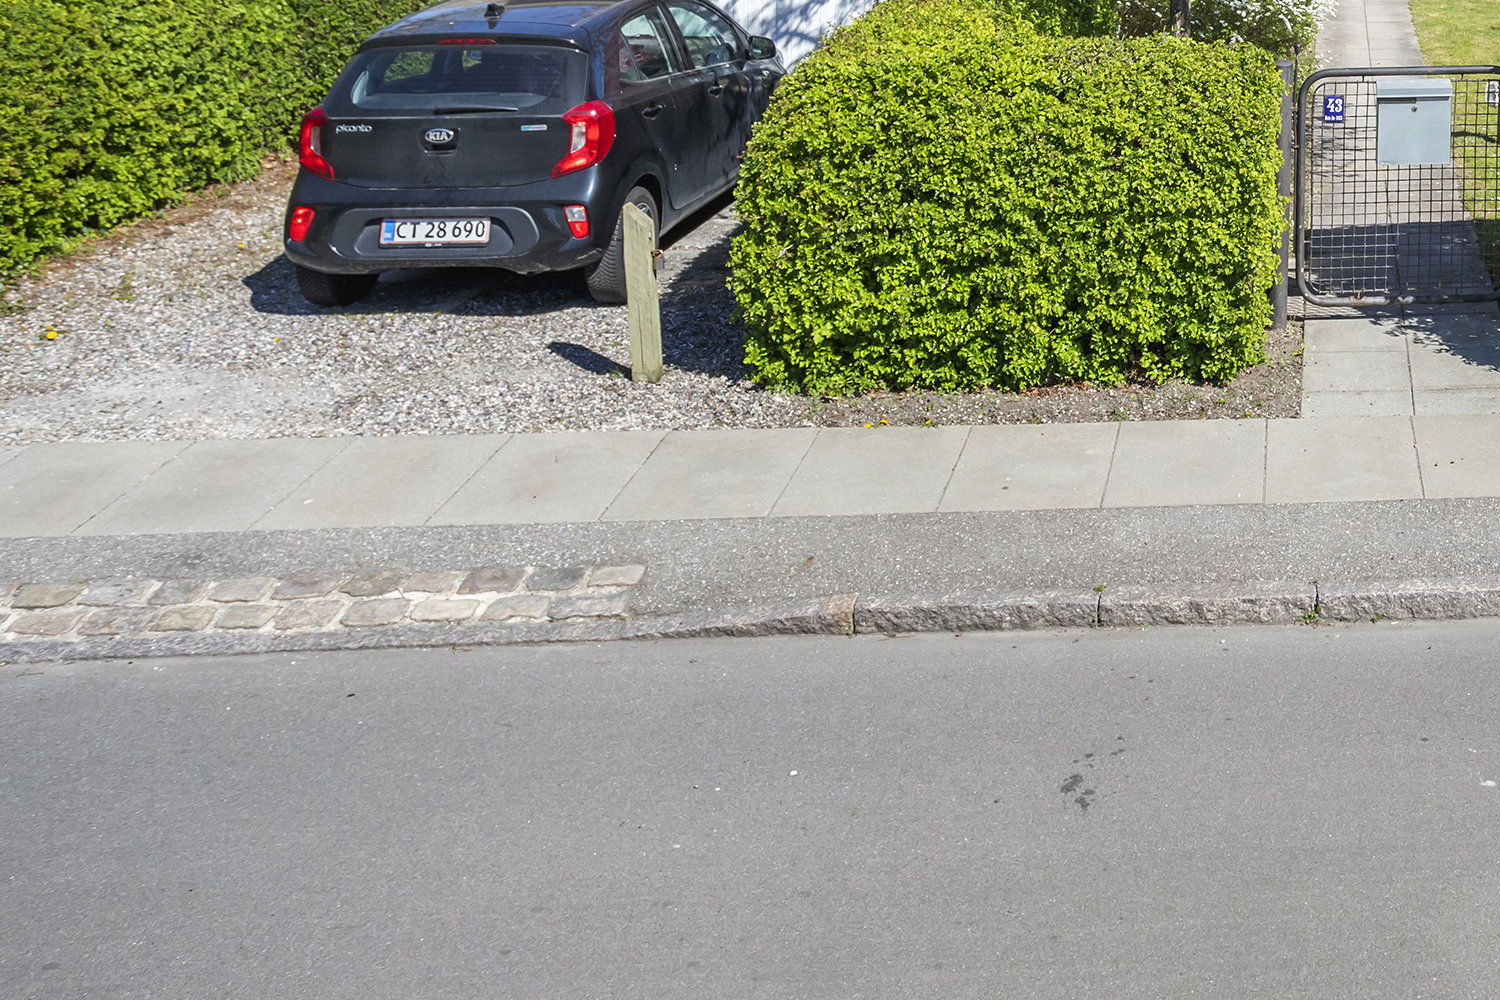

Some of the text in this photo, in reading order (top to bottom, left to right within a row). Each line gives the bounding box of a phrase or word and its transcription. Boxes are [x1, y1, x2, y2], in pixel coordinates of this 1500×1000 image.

[1326, 98, 1343, 113] 43
[335, 123, 373, 135] picanto
[428, 130, 449, 141] KIA
[396, 220, 486, 239] CT 28 690
